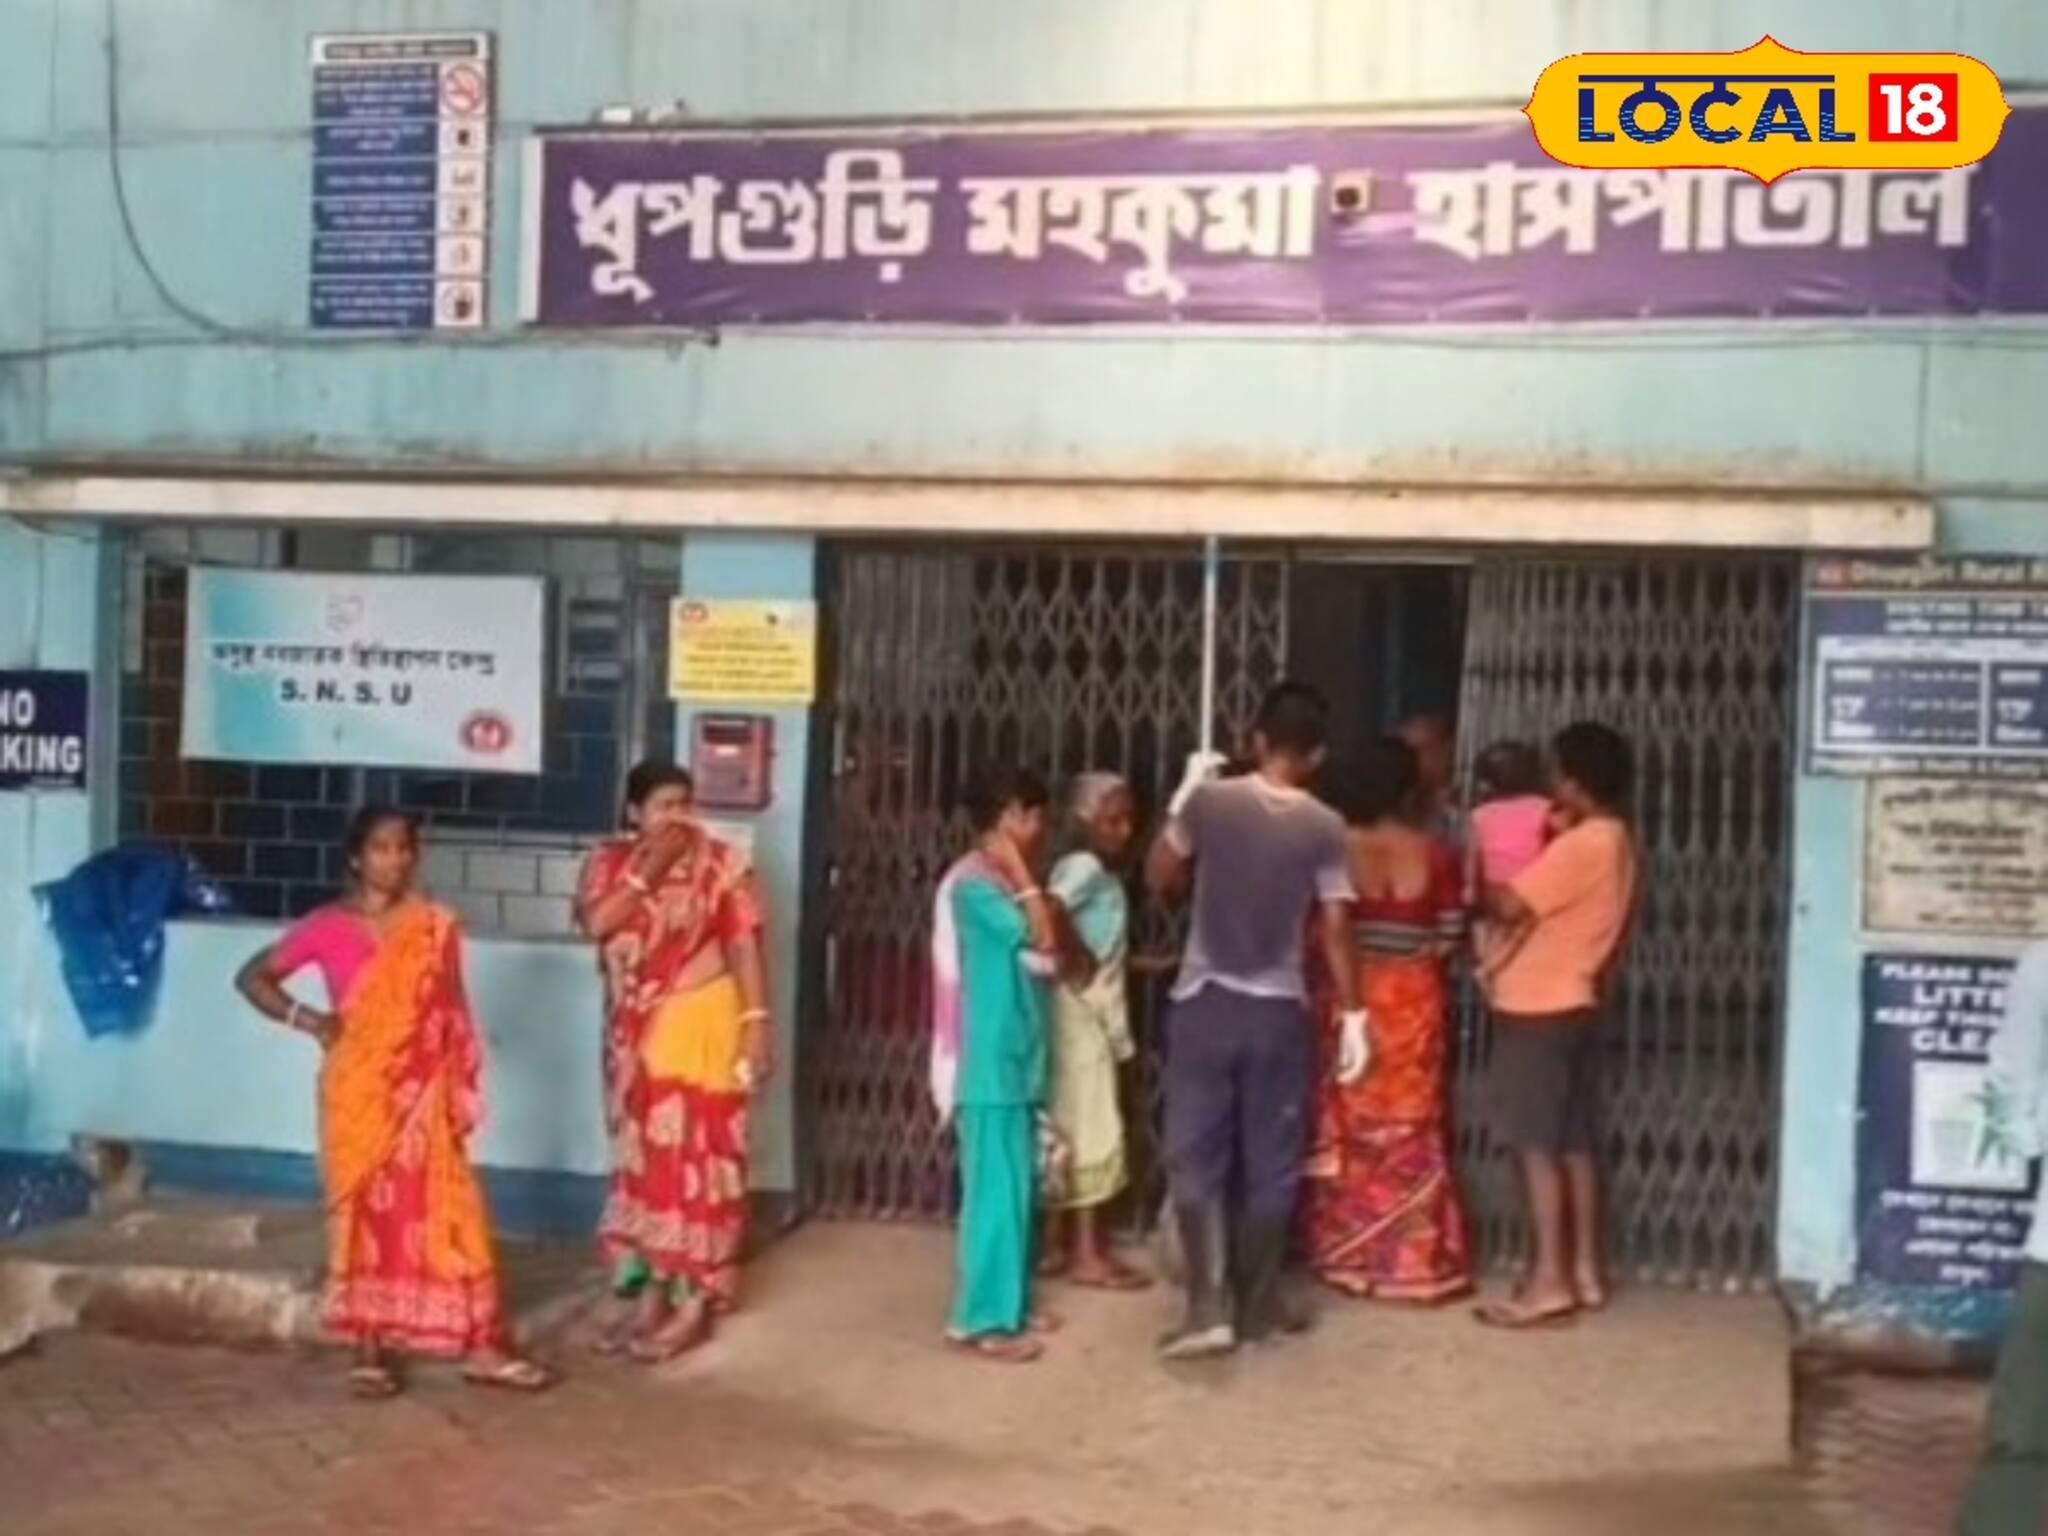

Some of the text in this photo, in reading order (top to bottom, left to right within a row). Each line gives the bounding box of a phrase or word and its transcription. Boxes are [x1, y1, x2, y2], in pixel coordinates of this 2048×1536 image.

[571, 149, 1985, 302] ধূপগুড়ি মহকুমা হাসপাতাল
[391, 684, 412, 705] U
[0, 733, 81, 773] KING
[1911, 1028, 1988, 1052] CLE
